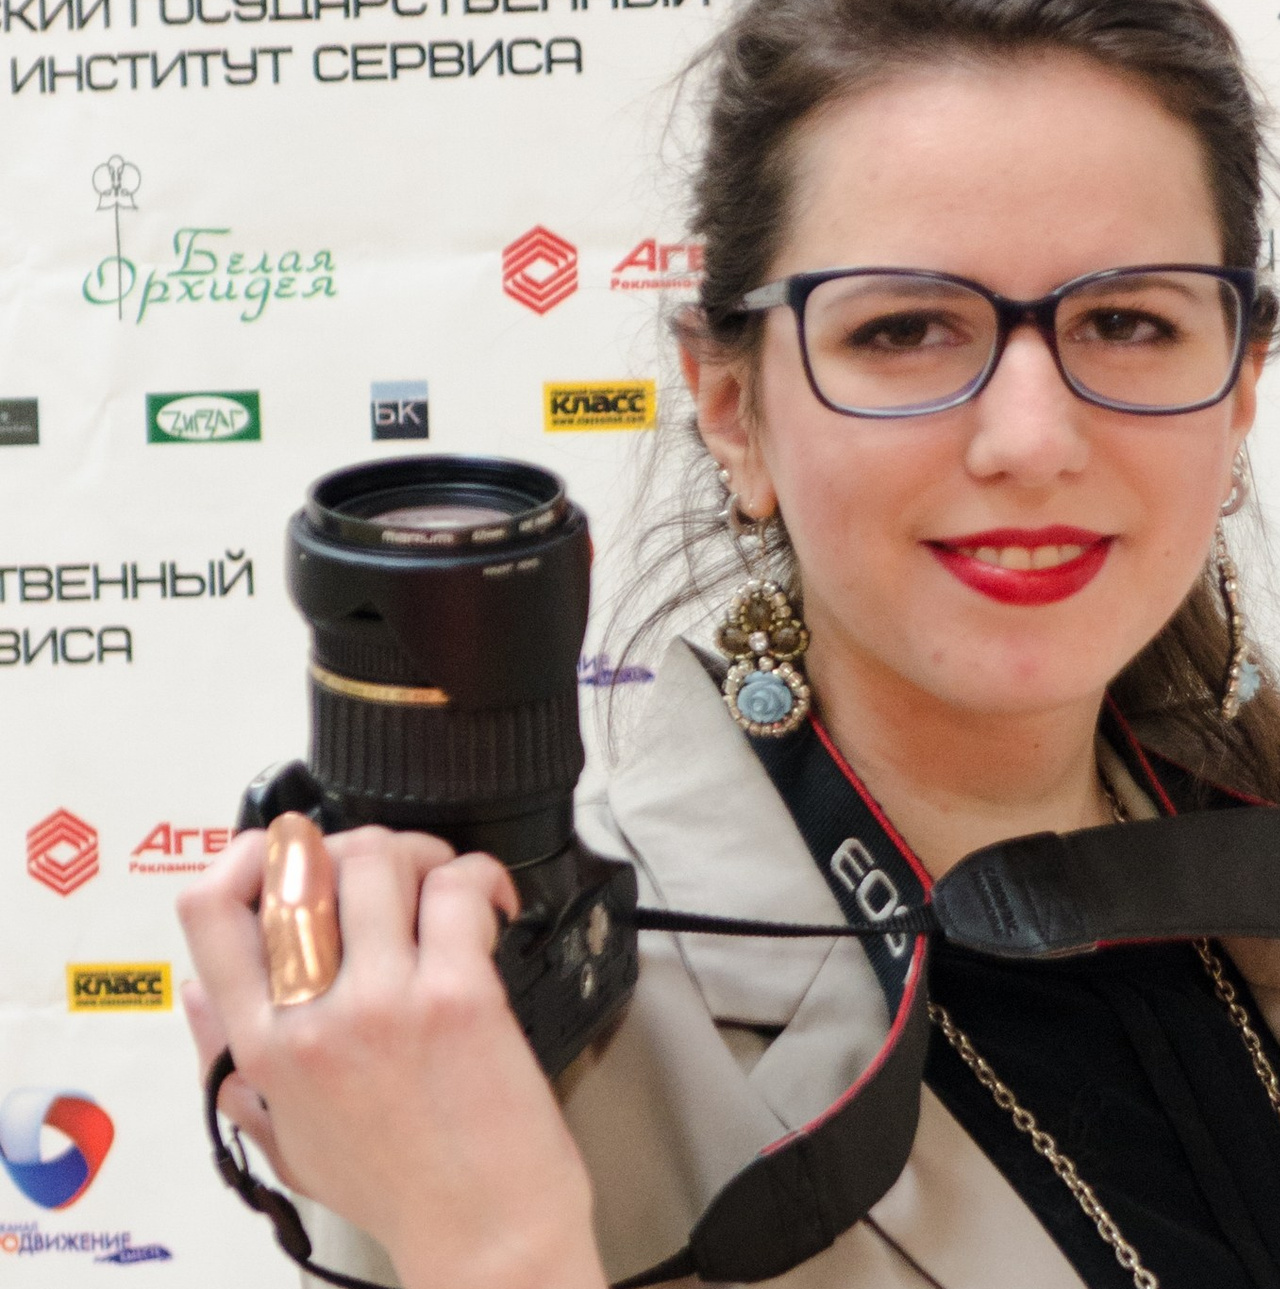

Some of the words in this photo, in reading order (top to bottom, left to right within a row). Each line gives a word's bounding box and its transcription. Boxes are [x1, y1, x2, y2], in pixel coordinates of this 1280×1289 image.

[11, 46, 293, 94] ИНСТИТУТ
[313, 37, 583, 82] СЕРВИСА
[163, 227, 338, 275] Белая
[82, 255, 340, 324] Орхидея
[374, 402, 421, 427] БК
